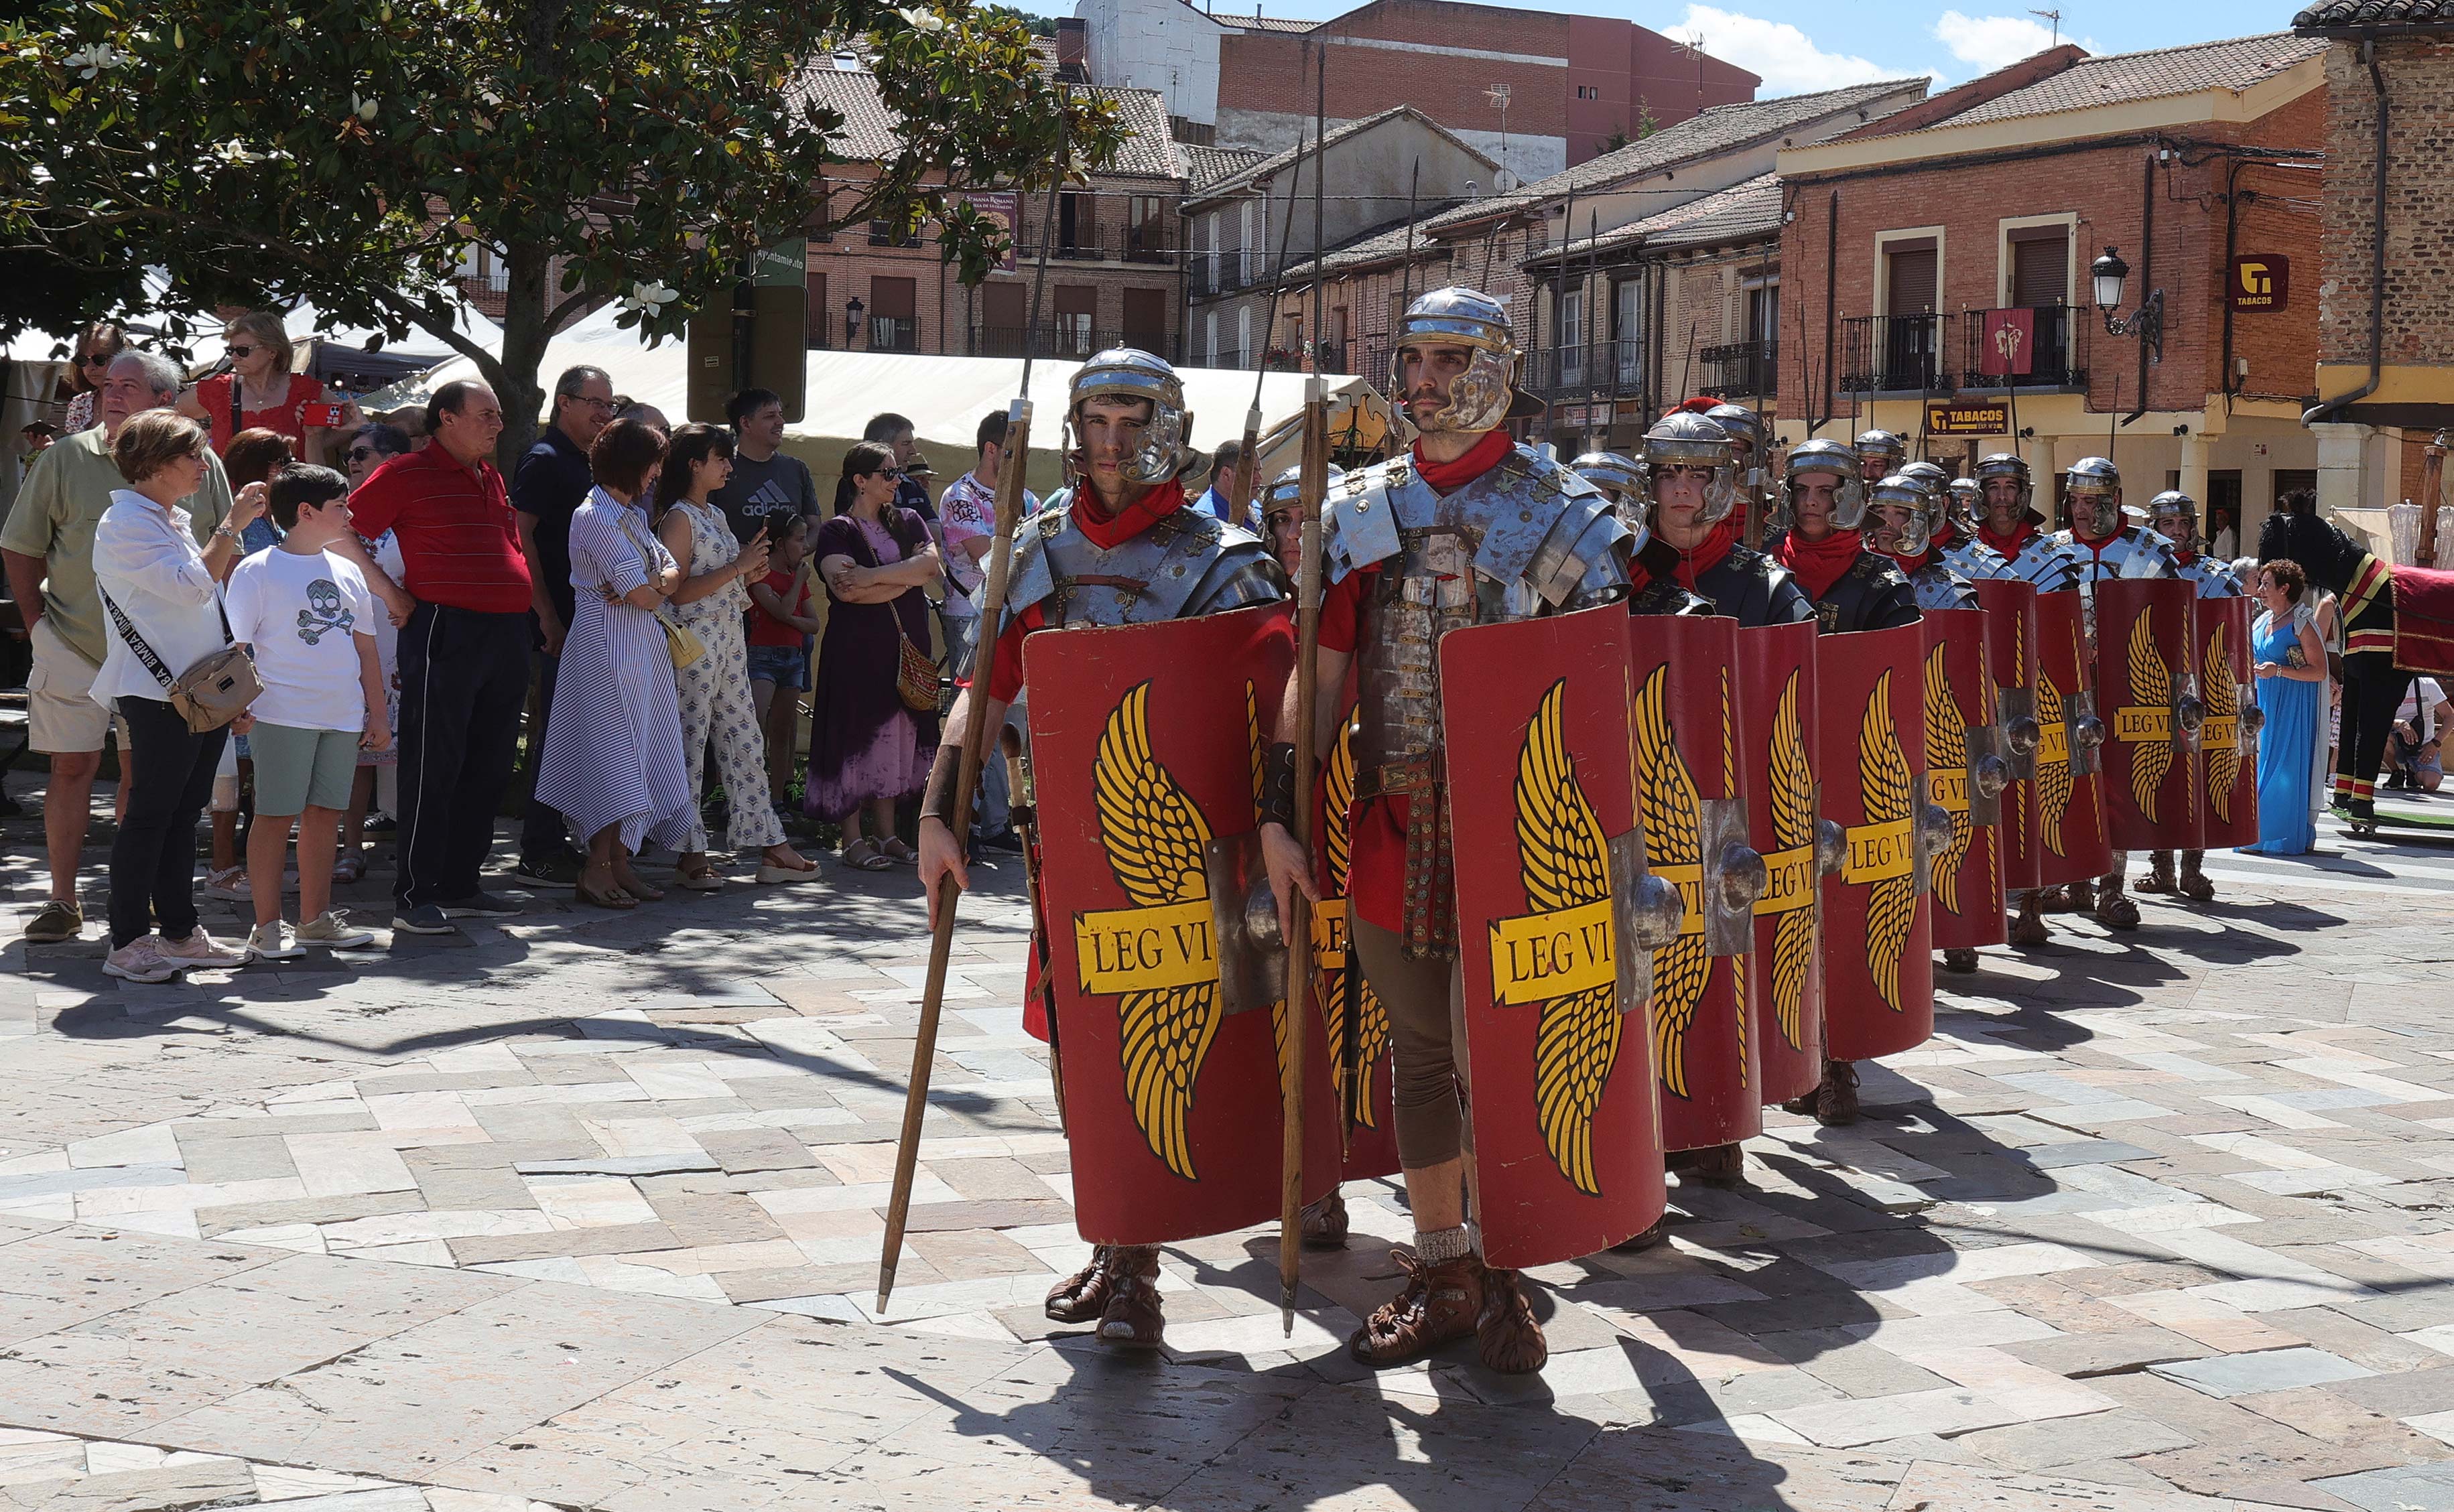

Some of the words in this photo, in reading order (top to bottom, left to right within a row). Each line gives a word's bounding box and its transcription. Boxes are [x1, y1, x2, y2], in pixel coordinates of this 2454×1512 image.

[990, 196, 1014, 205] ROMANA
[2237, 297, 2272, 305] TABACOS
[1949, 409, 2004, 423] TABACOS
[129, 633, 158, 668] BIMBA
[2122, 714, 2152, 733] LEG
[2155, 714, 2171, 733] VI
[2201, 724, 2222, 741] EG
[2048, 732, 2066, 752] VI
[1948, 778, 1968, 801] VI
[1850, 837, 1891, 870] LEG
[1894, 831, 1913, 862] VI
[1758, 865, 1796, 900] EG
[1799, 859, 1813, 892] VI
[1672, 880, 1703, 917] VI
[1090, 928, 1163, 973] LEG
[1171, 920, 1212, 964] VI
[1506, 931, 1573, 983] LEG
[1579, 920, 1610, 967] VI
